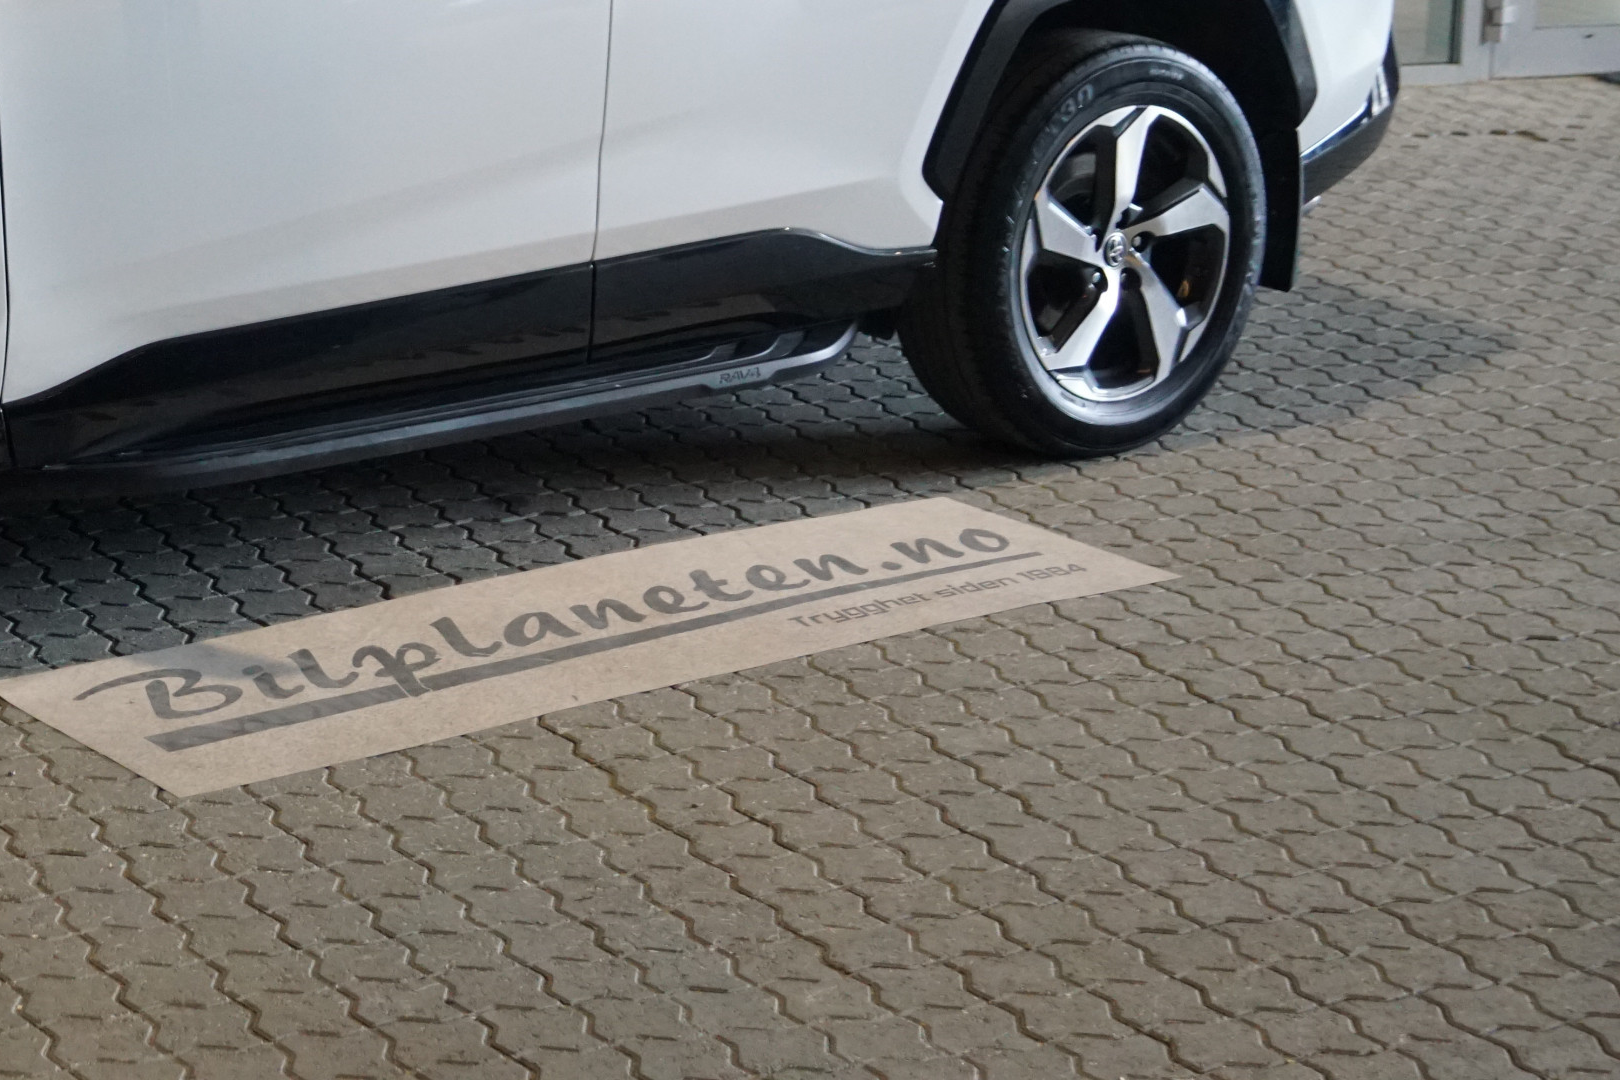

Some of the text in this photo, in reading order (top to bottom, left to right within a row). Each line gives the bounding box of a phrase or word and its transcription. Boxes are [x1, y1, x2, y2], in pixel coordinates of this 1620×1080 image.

[719, 367, 761, 384] RAV4
[77, 521, 1014, 720] Bilplaneten.no
[788, 563, 1087, 627] Trygghet siden 1984
